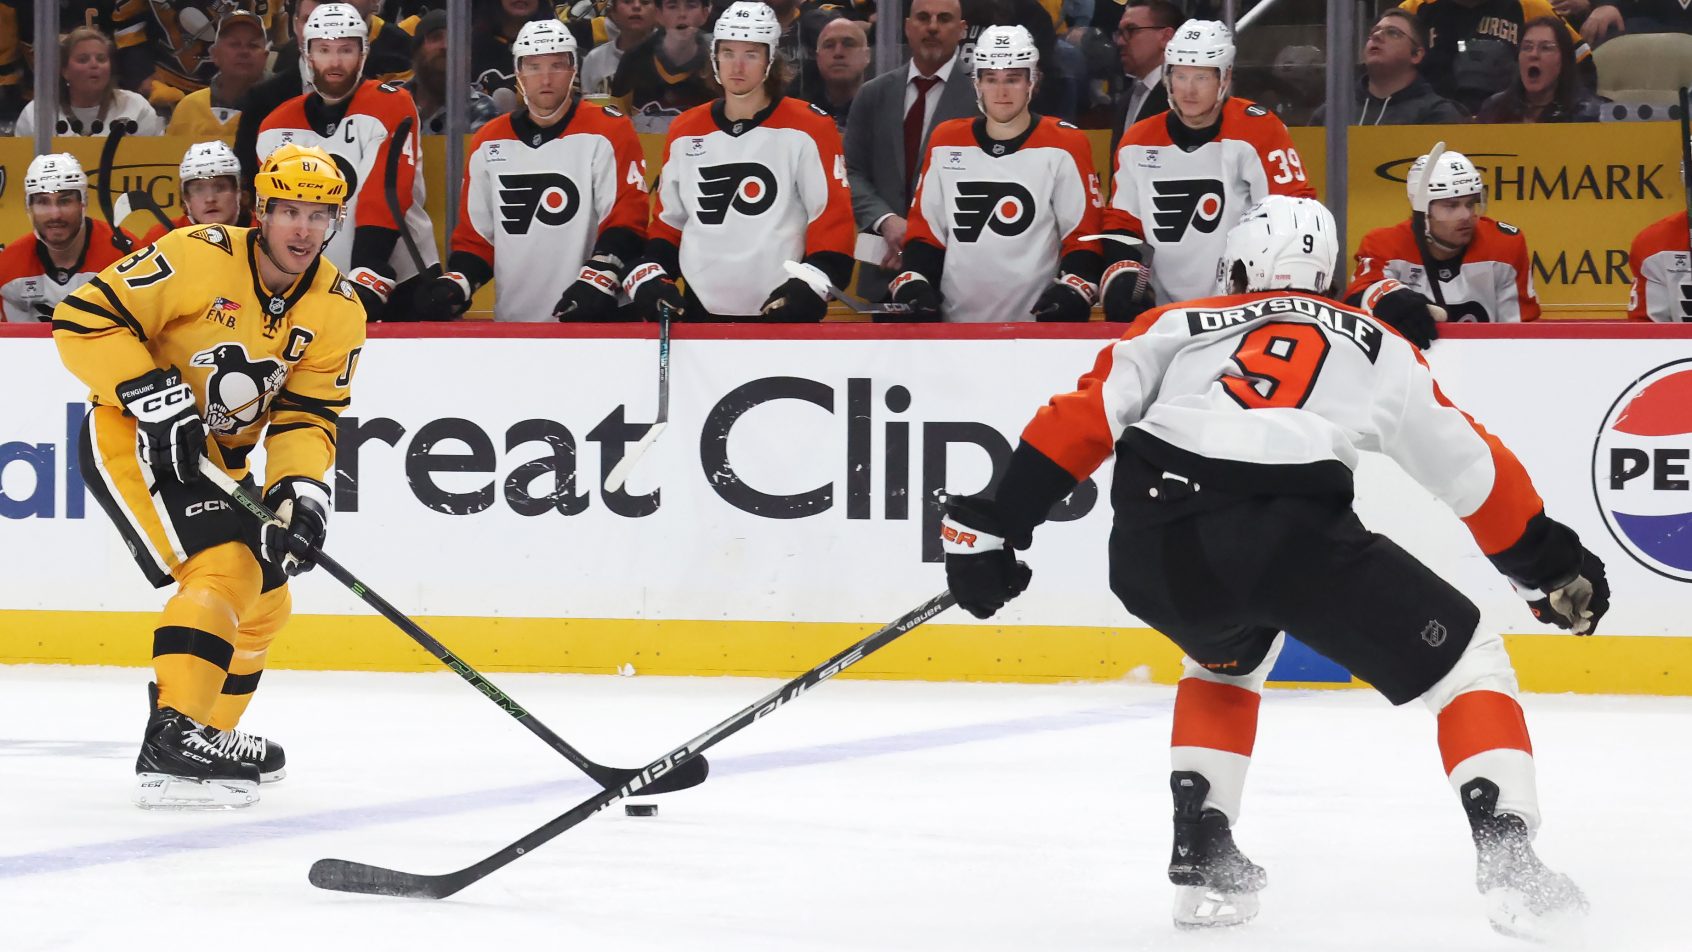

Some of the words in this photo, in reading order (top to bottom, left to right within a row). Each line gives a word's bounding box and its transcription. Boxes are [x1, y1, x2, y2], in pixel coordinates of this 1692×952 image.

[736, 10, 750, 18] 46
[993, 35, 1010, 45] 52
[1185, 30, 1200, 41] 39
[344, 119, 353, 143] C
[302, 161, 318, 173] 87
[1267, 148, 1307, 185] 39
[1302, 233, 1314, 254] 9
[1531, 249, 1632, 285] MAR
[206, 308, 237, 331] F.N.B.
[1199, 297, 1374, 354] DRYSDALE
[284, 325, 315, 363] C
[1216, 321, 1332, 410] 9
[122, 383, 155, 400] PENGUINS
[166, 375, 178, 387] 87
[0, 402, 86, 520] al
[334, 403, 662, 518] reat
[700, 375, 1099, 563] Clip
[1609, 447, 1692, 491] PE
[236, 493, 269, 520] CCM
[182, 750, 213, 765] CCM
